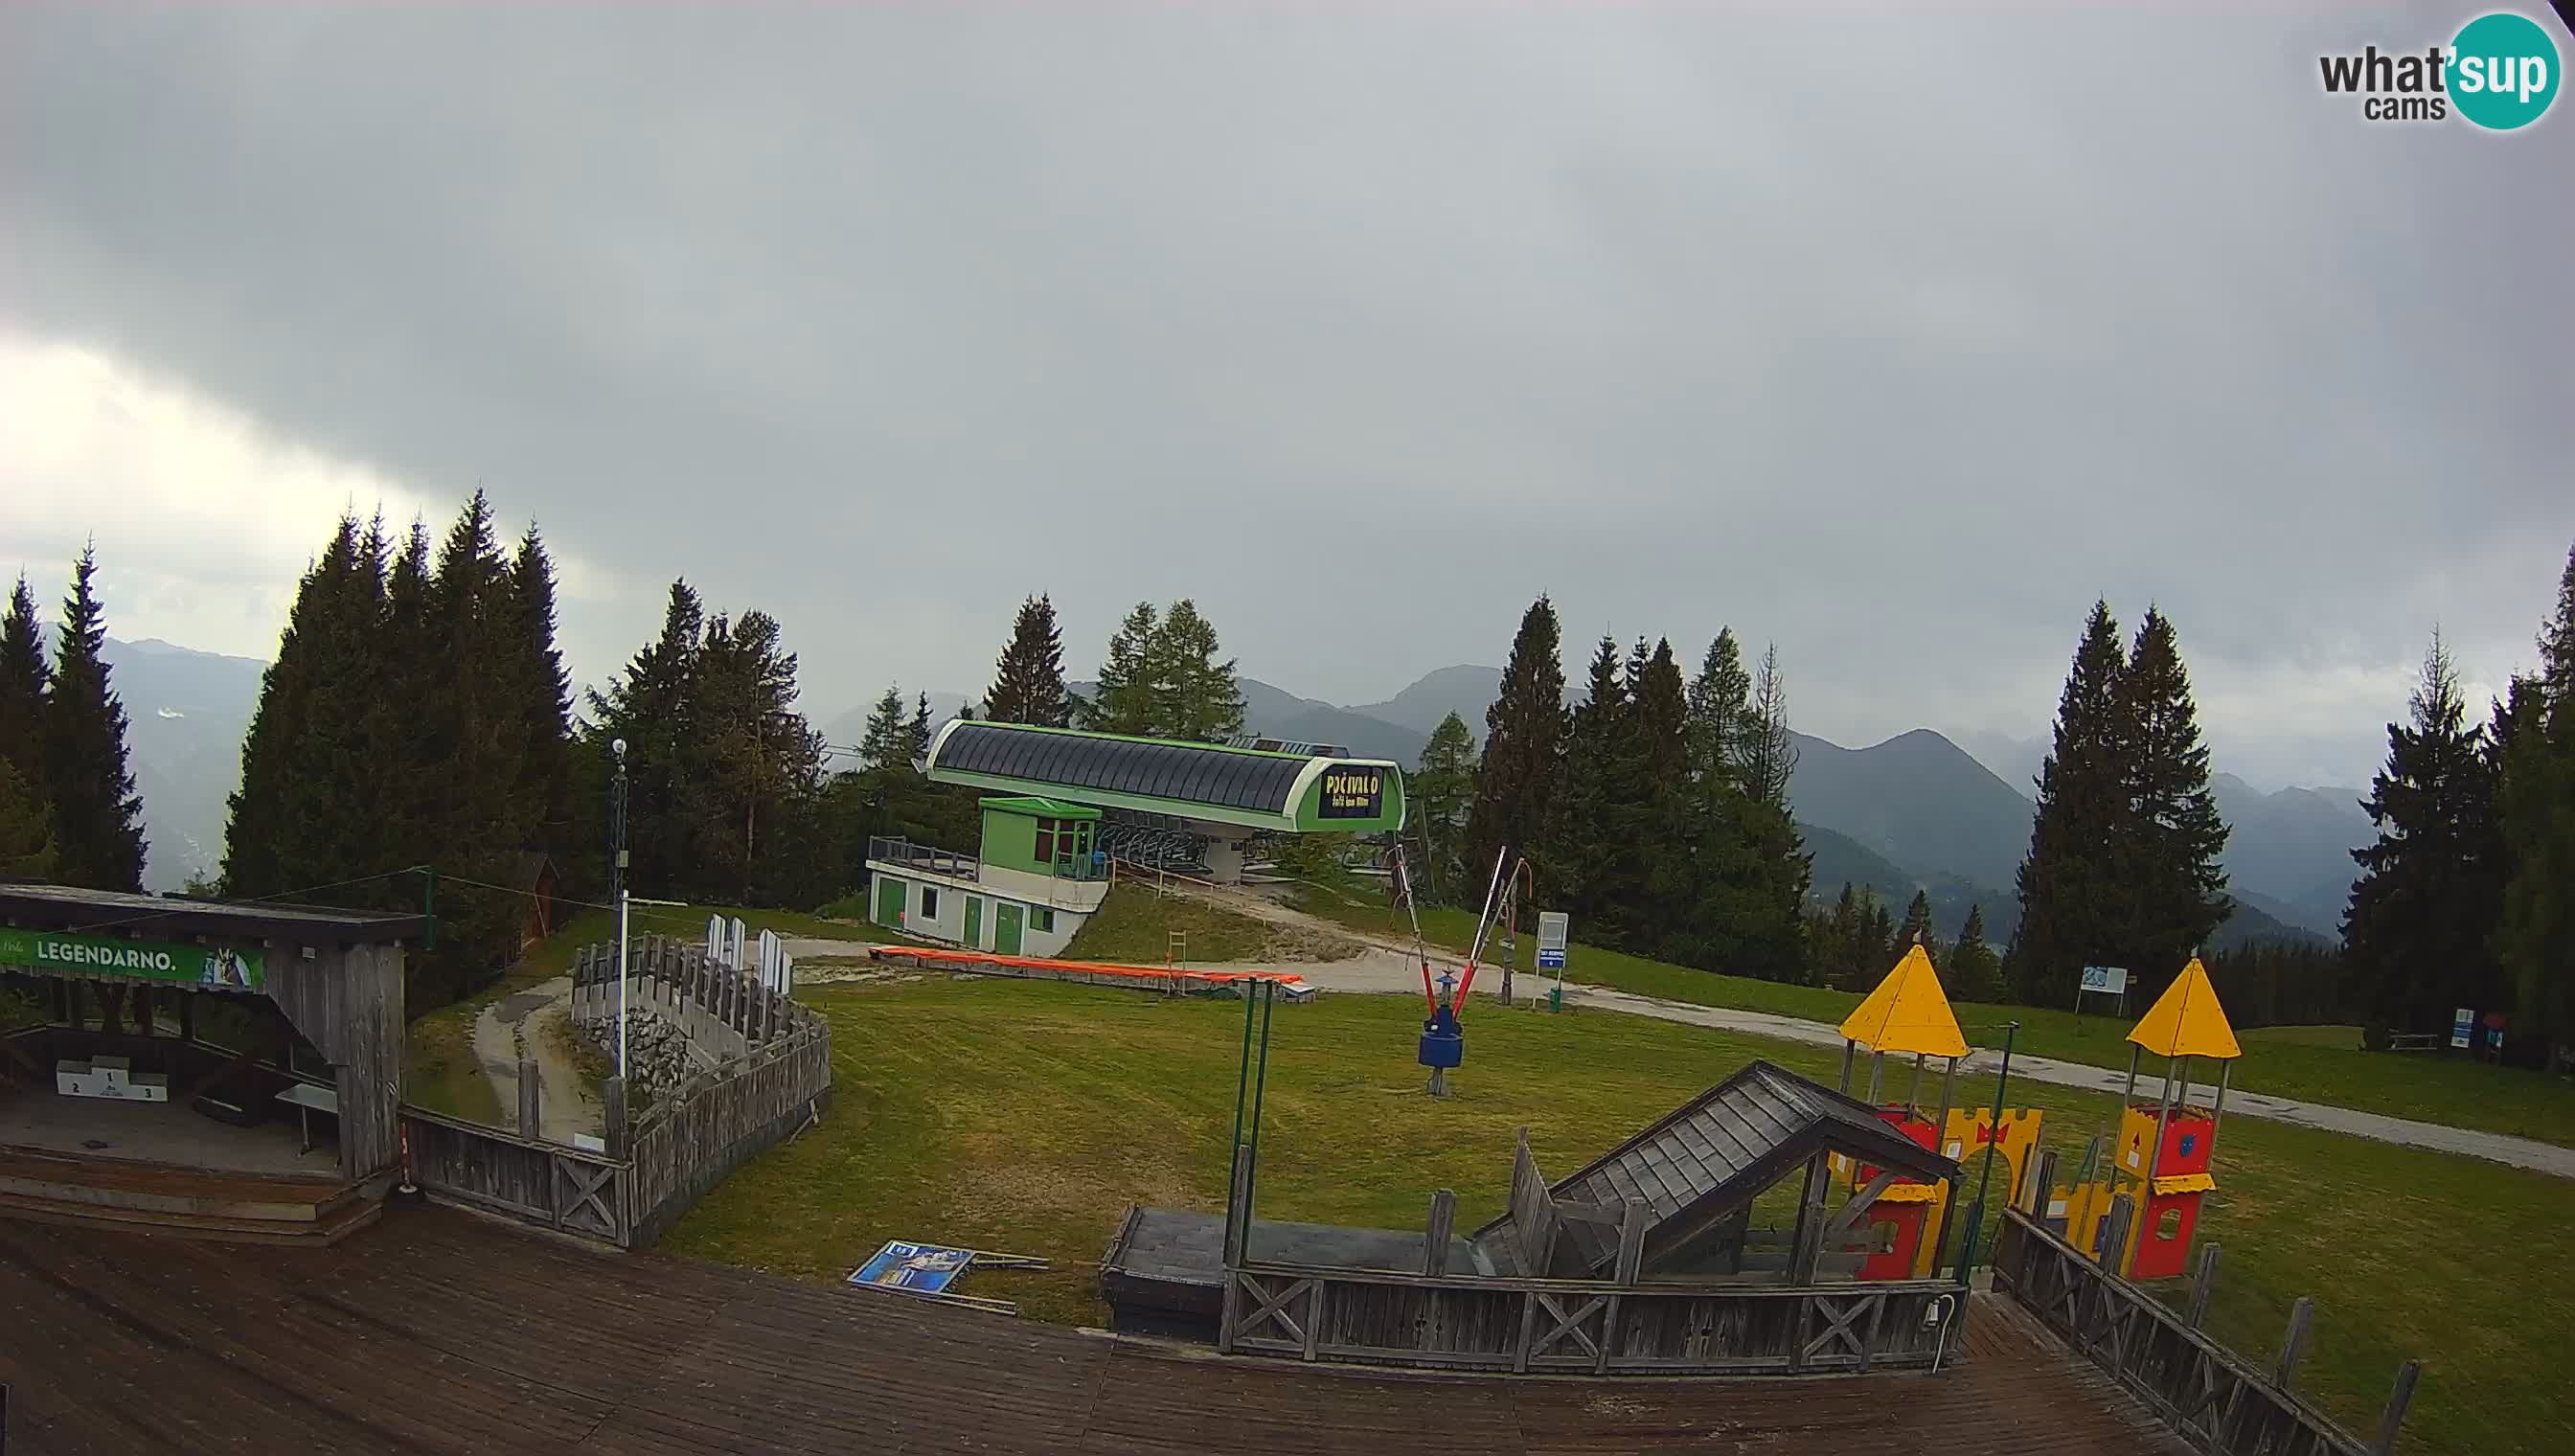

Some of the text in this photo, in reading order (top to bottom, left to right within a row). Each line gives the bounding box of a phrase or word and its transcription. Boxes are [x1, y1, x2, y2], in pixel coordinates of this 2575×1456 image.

[37, 941, 176, 971] LEGENDARNO.
[106, 1072, 112, 1081] 1
[72, 1083, 80, 1093] 2
[145, 1088, 152, 1098] 3
